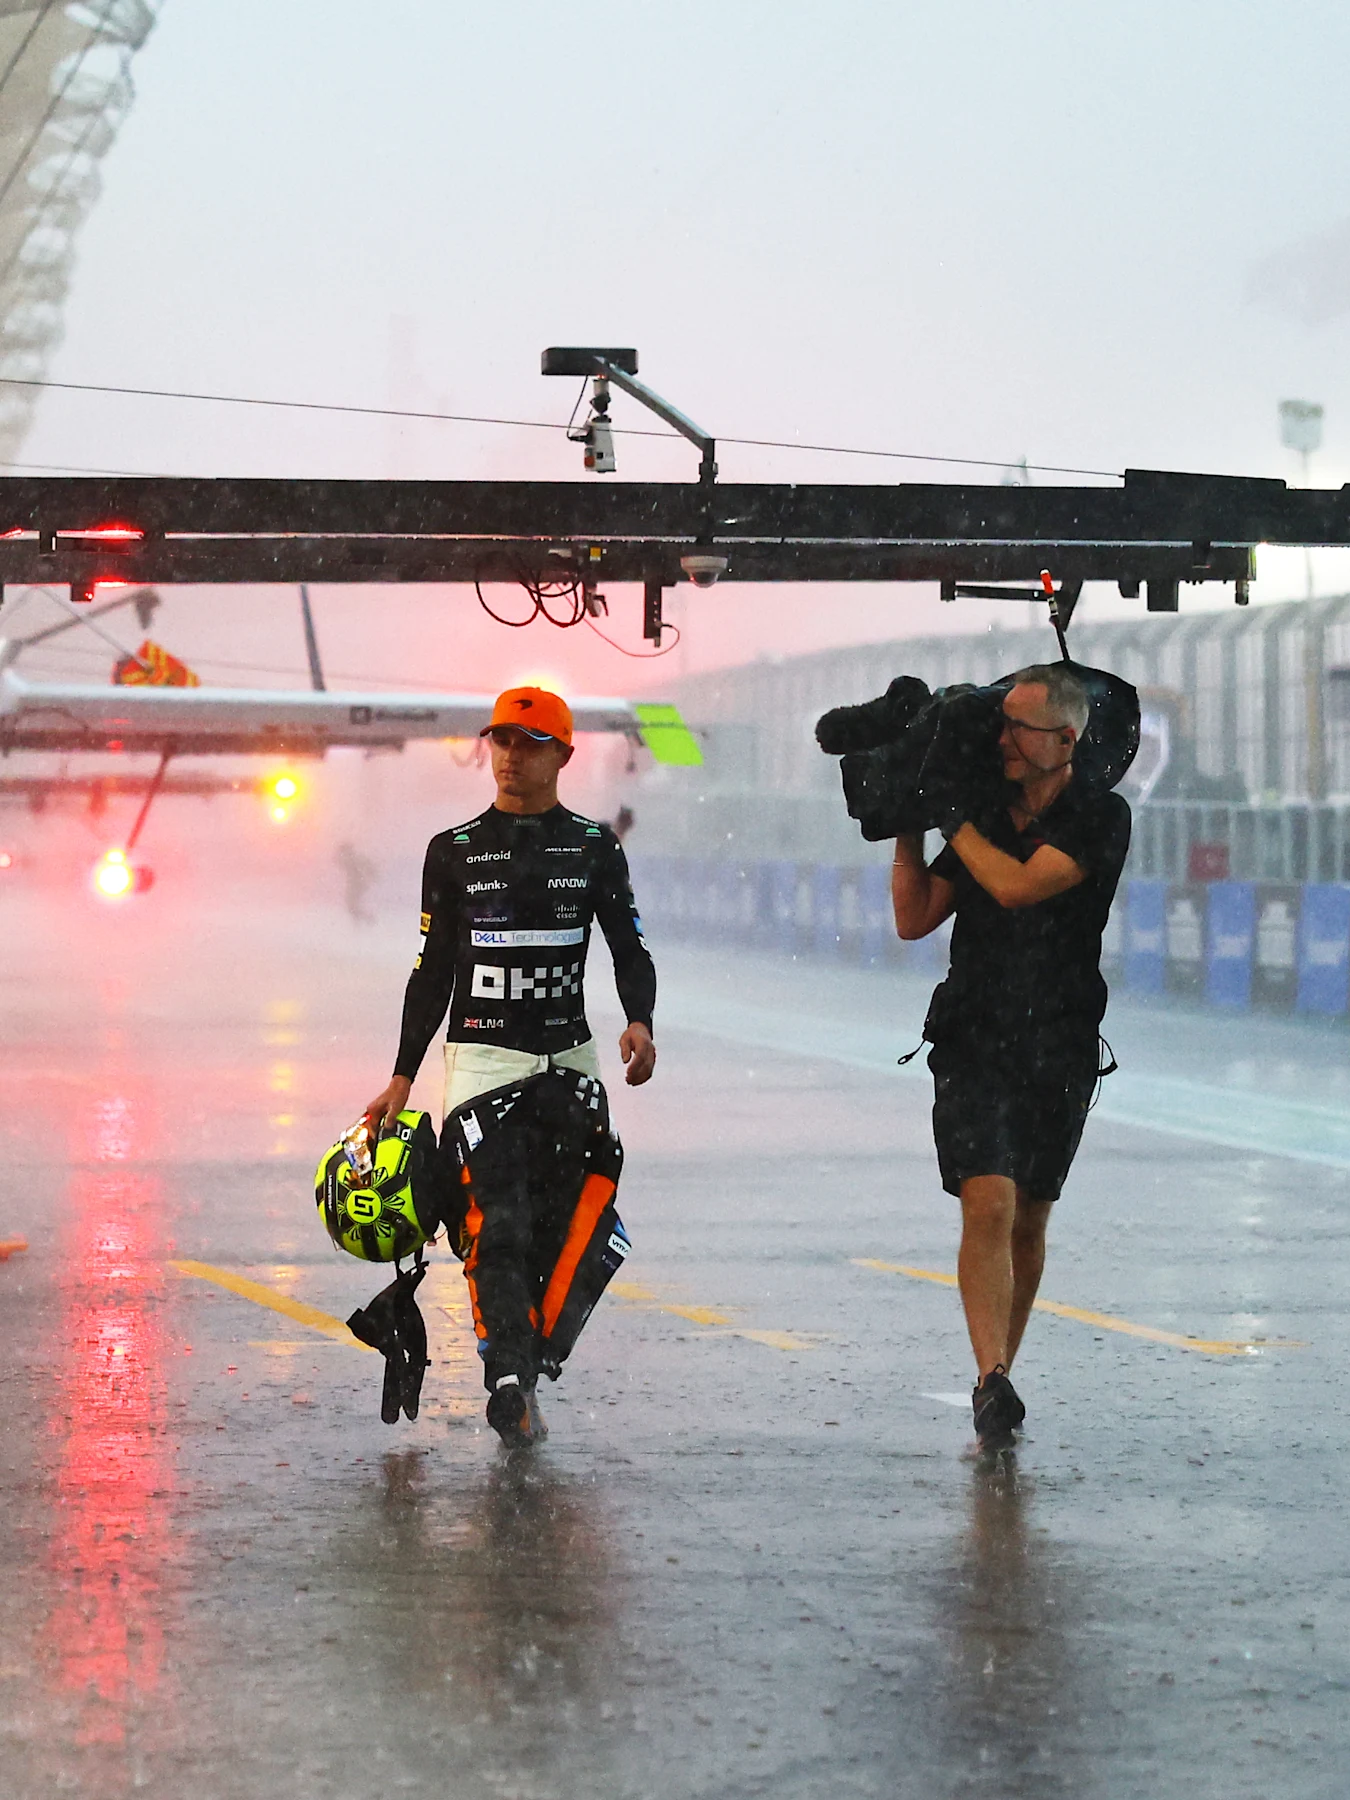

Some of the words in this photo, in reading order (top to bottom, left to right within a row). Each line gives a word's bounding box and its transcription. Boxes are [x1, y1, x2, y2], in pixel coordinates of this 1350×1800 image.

[466, 851, 511, 864] android
[548, 878, 587, 889] ARROW
[474, 932, 507, 943] DELL
[471, 962, 580, 1000] OKX
[479, 1018, 505, 1029] LN4
